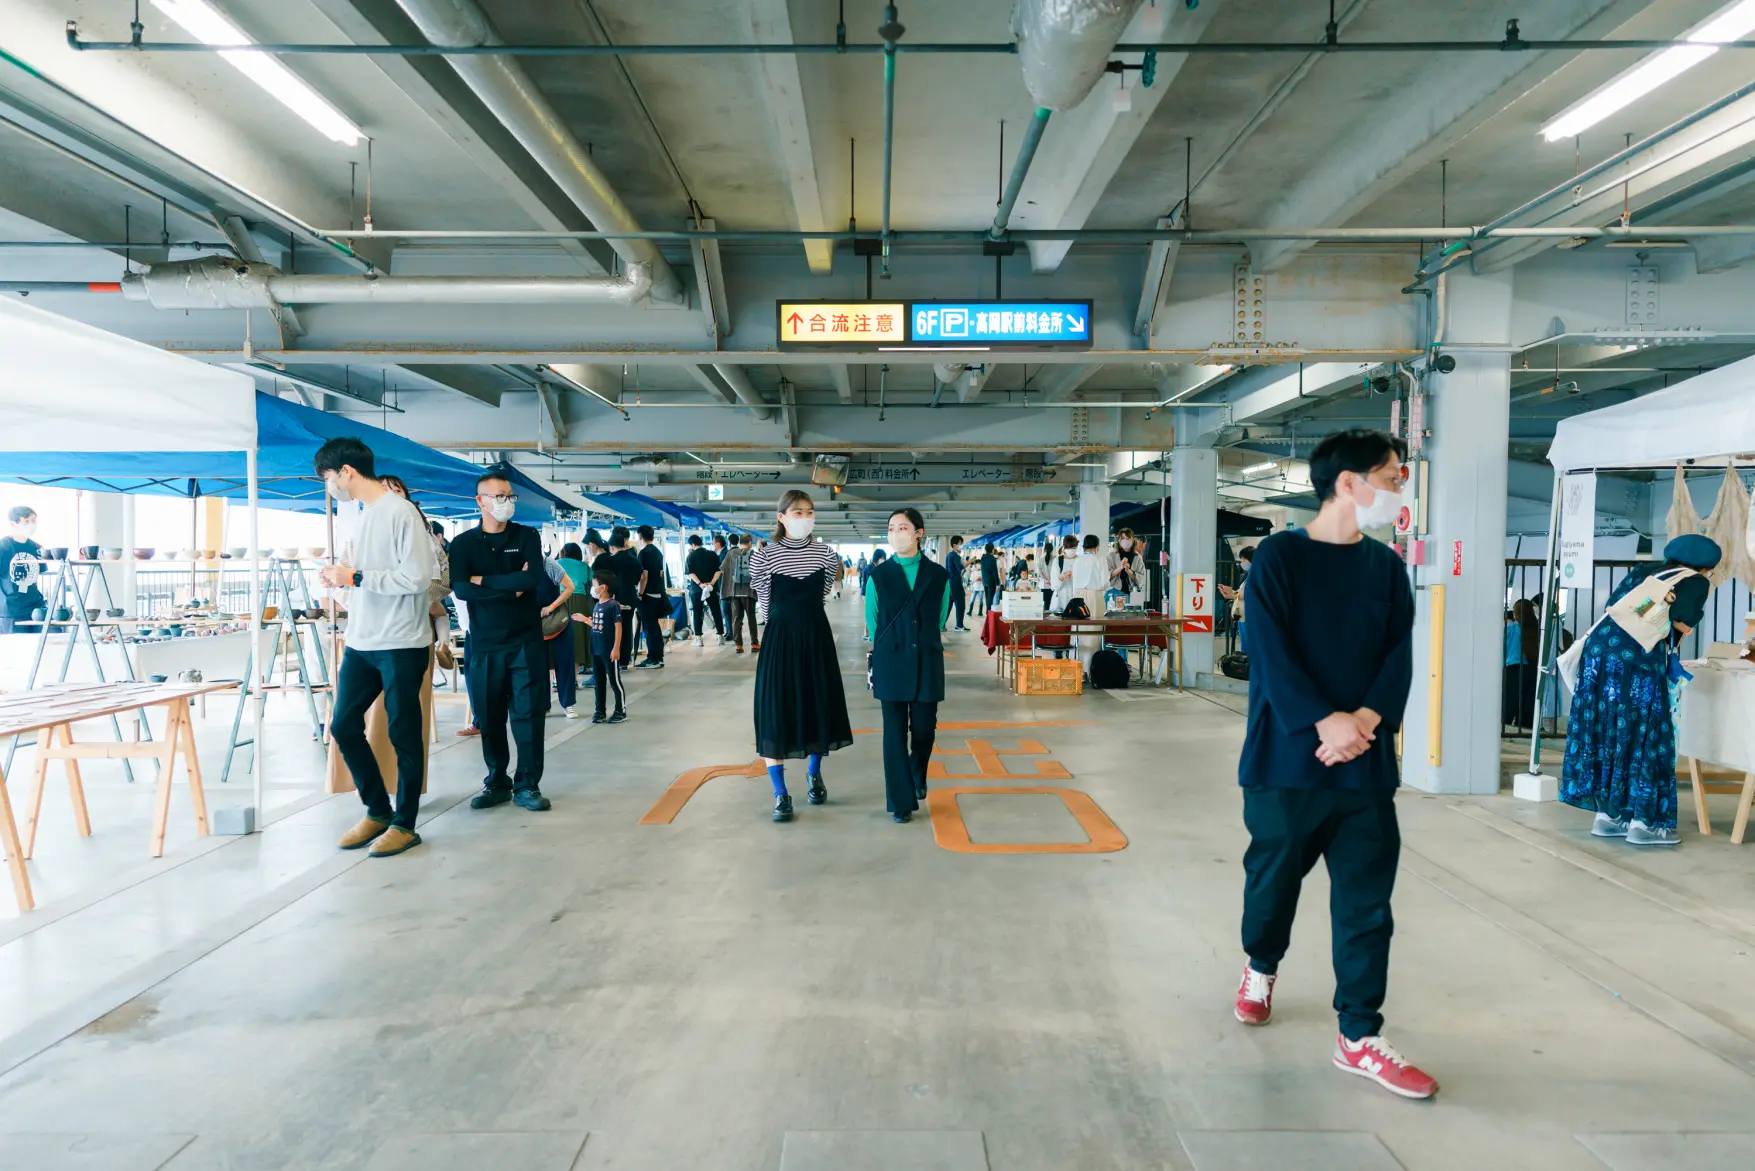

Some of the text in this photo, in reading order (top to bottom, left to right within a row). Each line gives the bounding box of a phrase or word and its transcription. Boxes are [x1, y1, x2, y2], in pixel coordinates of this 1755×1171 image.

[809, 313, 894, 333] 合流注意
[1189, 578, 1206, 611] 下り
